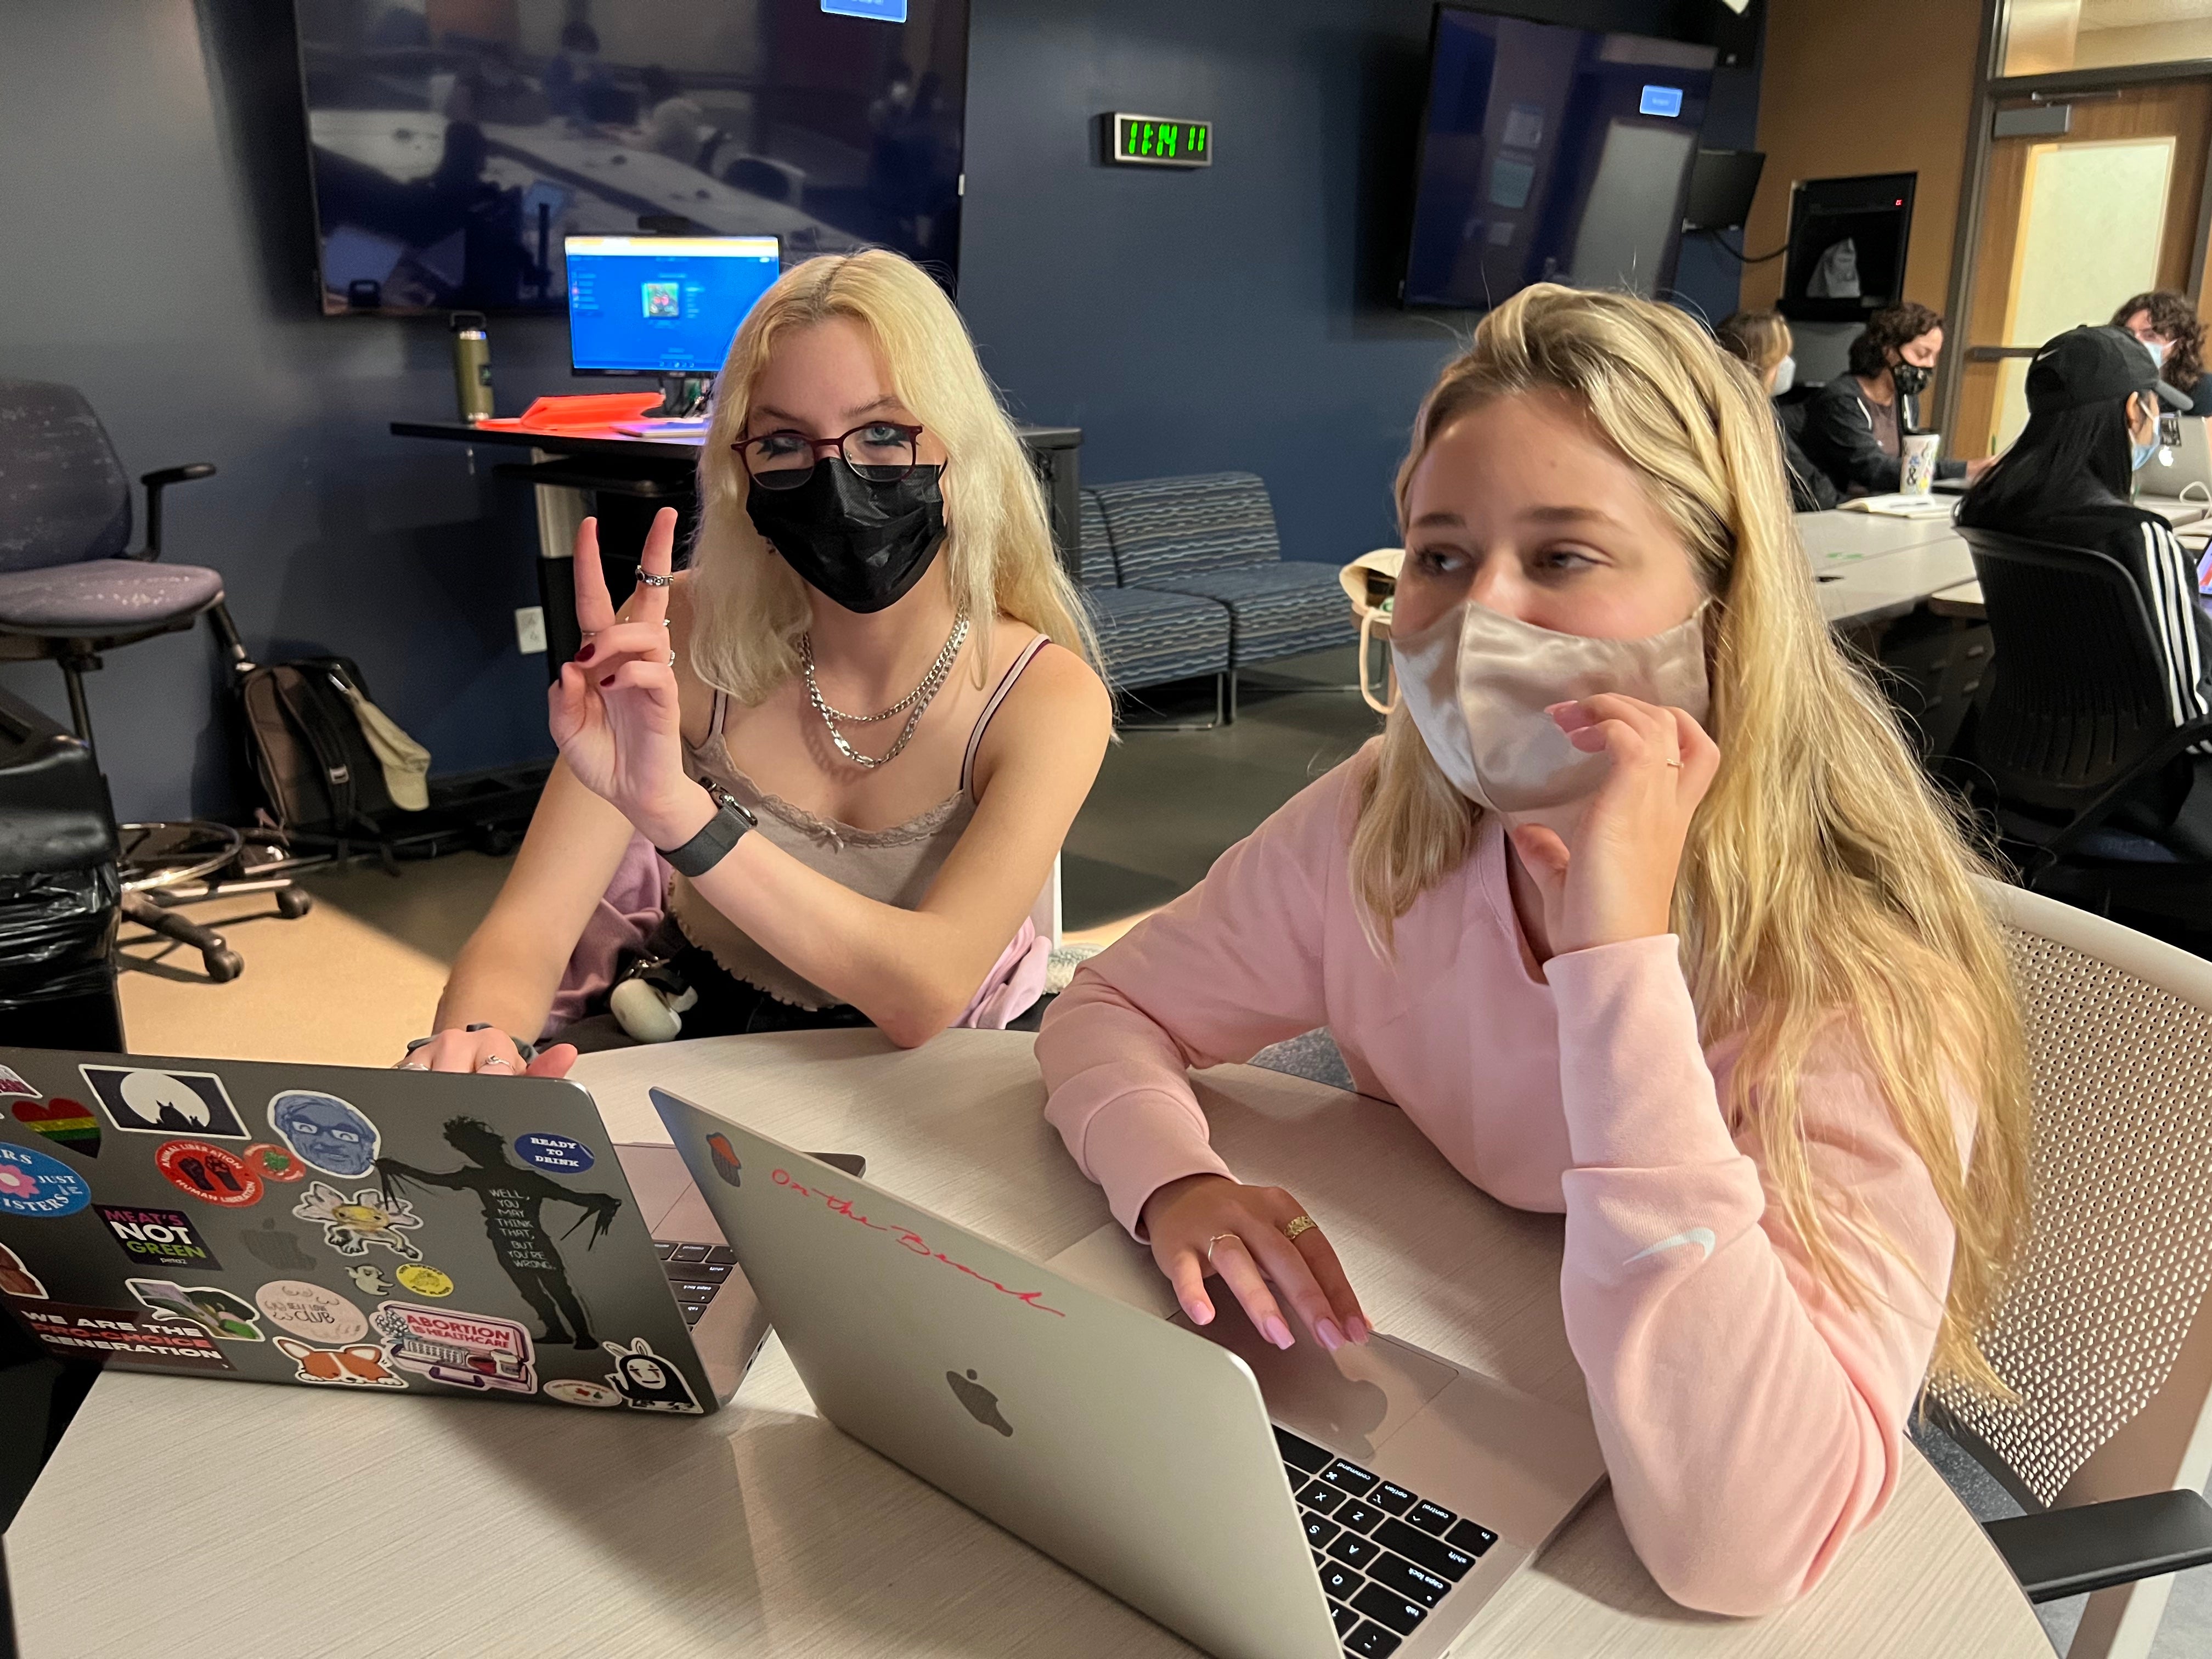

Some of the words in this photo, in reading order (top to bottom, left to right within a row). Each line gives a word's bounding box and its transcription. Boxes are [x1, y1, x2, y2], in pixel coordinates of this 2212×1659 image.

[1188, 125, 1205, 153] 11
[530, 1137, 577, 1149] READY
[0, 1149, 33, 1165] RS
[161, 1144, 179, 1169] ANIMAL
[180, 1143, 243, 1170] LIBERATION
[535, 1155, 579, 1167] DRINK
[37, 1175, 76, 1184] JUST
[176, 1179, 218, 1201] HUMAN
[221, 1180, 256, 1203] LIBERATION
[2, 1193, 69, 1211] ISTERS
[496, 1199, 520, 1208] YOU
[772, 1169, 810, 1197] On
[811, 1187, 888, 1232] the
[104, 1209, 184, 1226] MEAT'S
[498, 1209, 524, 1218] MAY
[495, 1218, 534, 1228] THINK
[110, 1221, 193, 1245] NOT
[127, 1241, 207, 1259] GREEN
[511, 1240, 533, 1250] BUT
[507, 1250, 548, 1260] YOU'RE
[21, 1310, 68, 1325] WE
[77, 1318, 137, 1331] ARE
[142, 1324, 205, 1338] THE
[294, 1310, 335, 1324] CLUB
[407, 1314, 510, 1341] ABORTION
[30, 1322, 213, 1348] PRO-CHOICE
[412, 1325, 426, 1334] IS
[428, 1328, 509, 1348] HEALTHCARE
[40, 1334, 223, 1359] GENERATION
[1336, 1462, 1371, 1480] command
[1314, 1492, 1327, 1502] X
[1385, 1485, 1408, 1498] option
[1352, 1511, 1364, 1521] Z
[1422, 1504, 1449, 1519] control
[1309, 1525, 1320, 1534] S
[1348, 1544, 1359, 1554] A
[1448, 1551, 1467, 1564] shift
[1332, 1574, 1343, 1585] Q
[1408, 1567, 1425, 1581] lock
[1425, 1576, 1443, 1589] caps
[1406, 1605, 1420, 1617] tab
